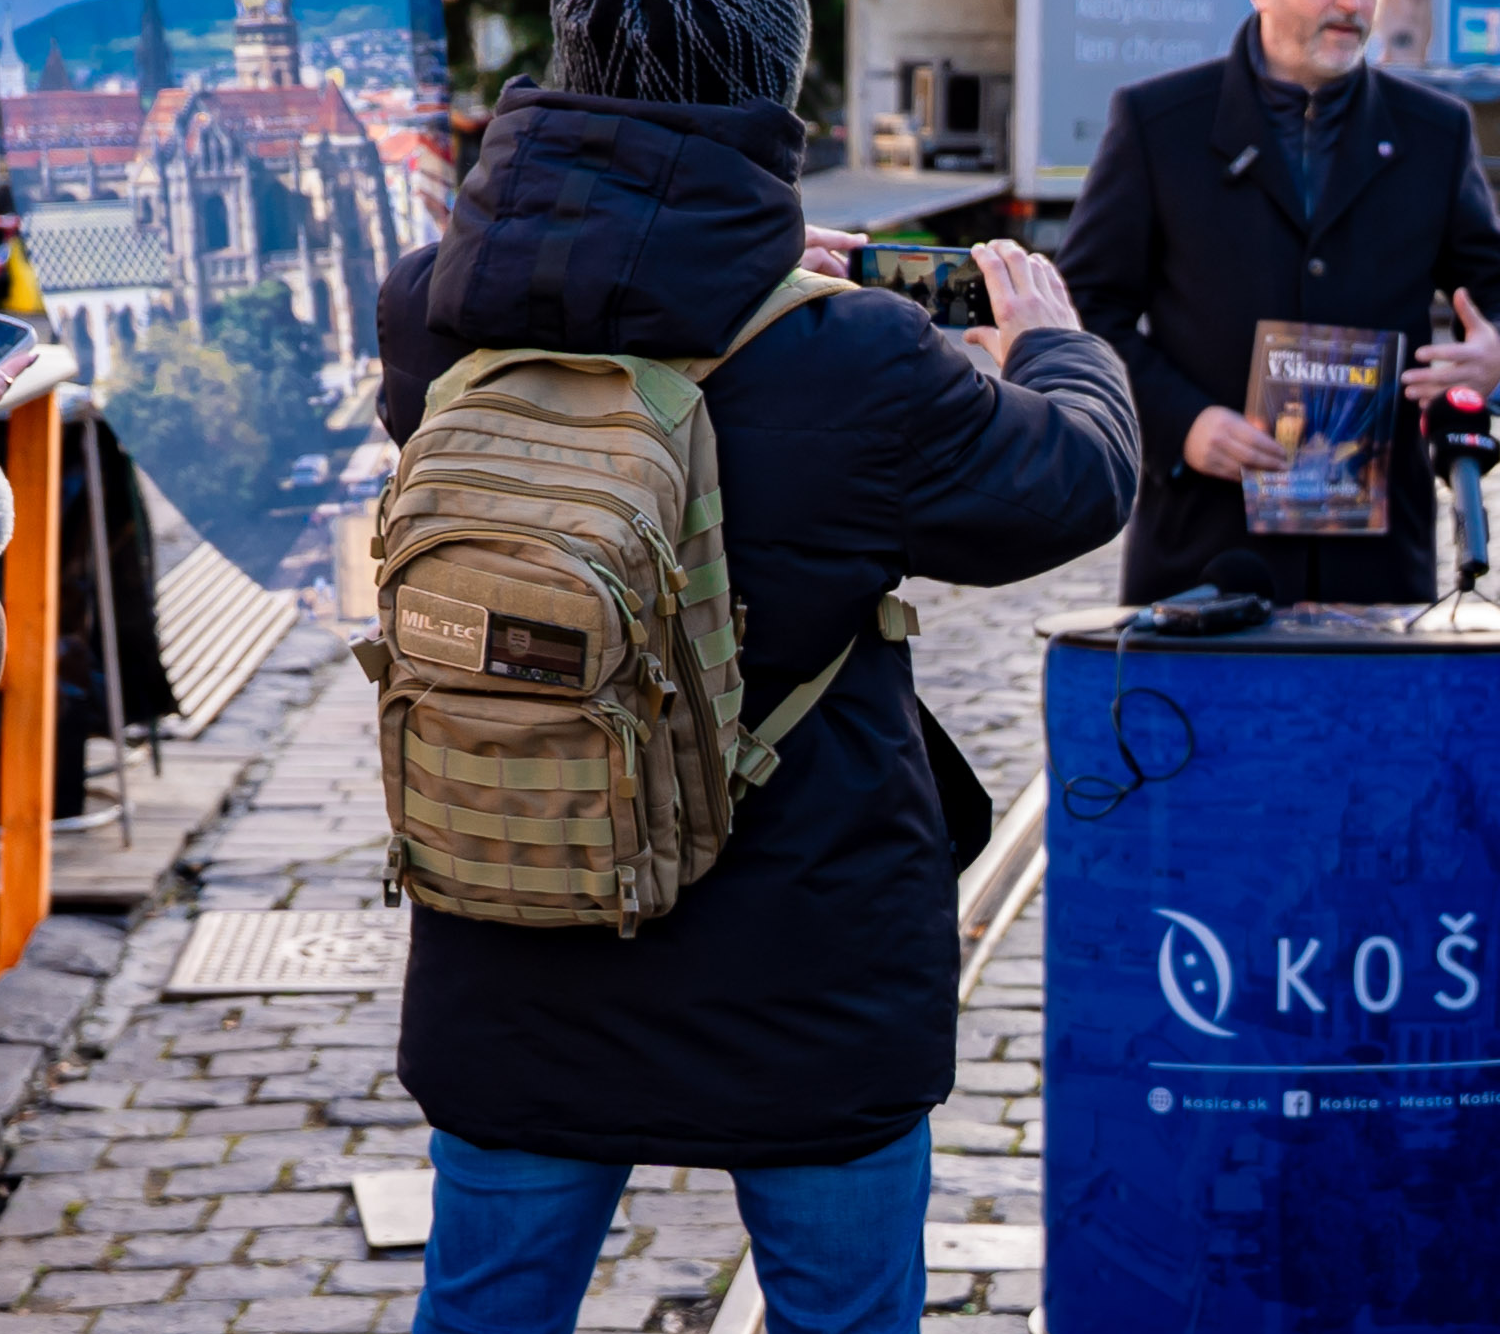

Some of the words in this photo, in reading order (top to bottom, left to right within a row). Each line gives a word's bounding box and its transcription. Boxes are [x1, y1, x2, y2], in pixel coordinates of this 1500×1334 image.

[1183, 1095, 1268, 1110] kosice.sk
[1320, 1096, 1379, 1110] Košice
[1399, 1095, 1453, 1108] Mesto
